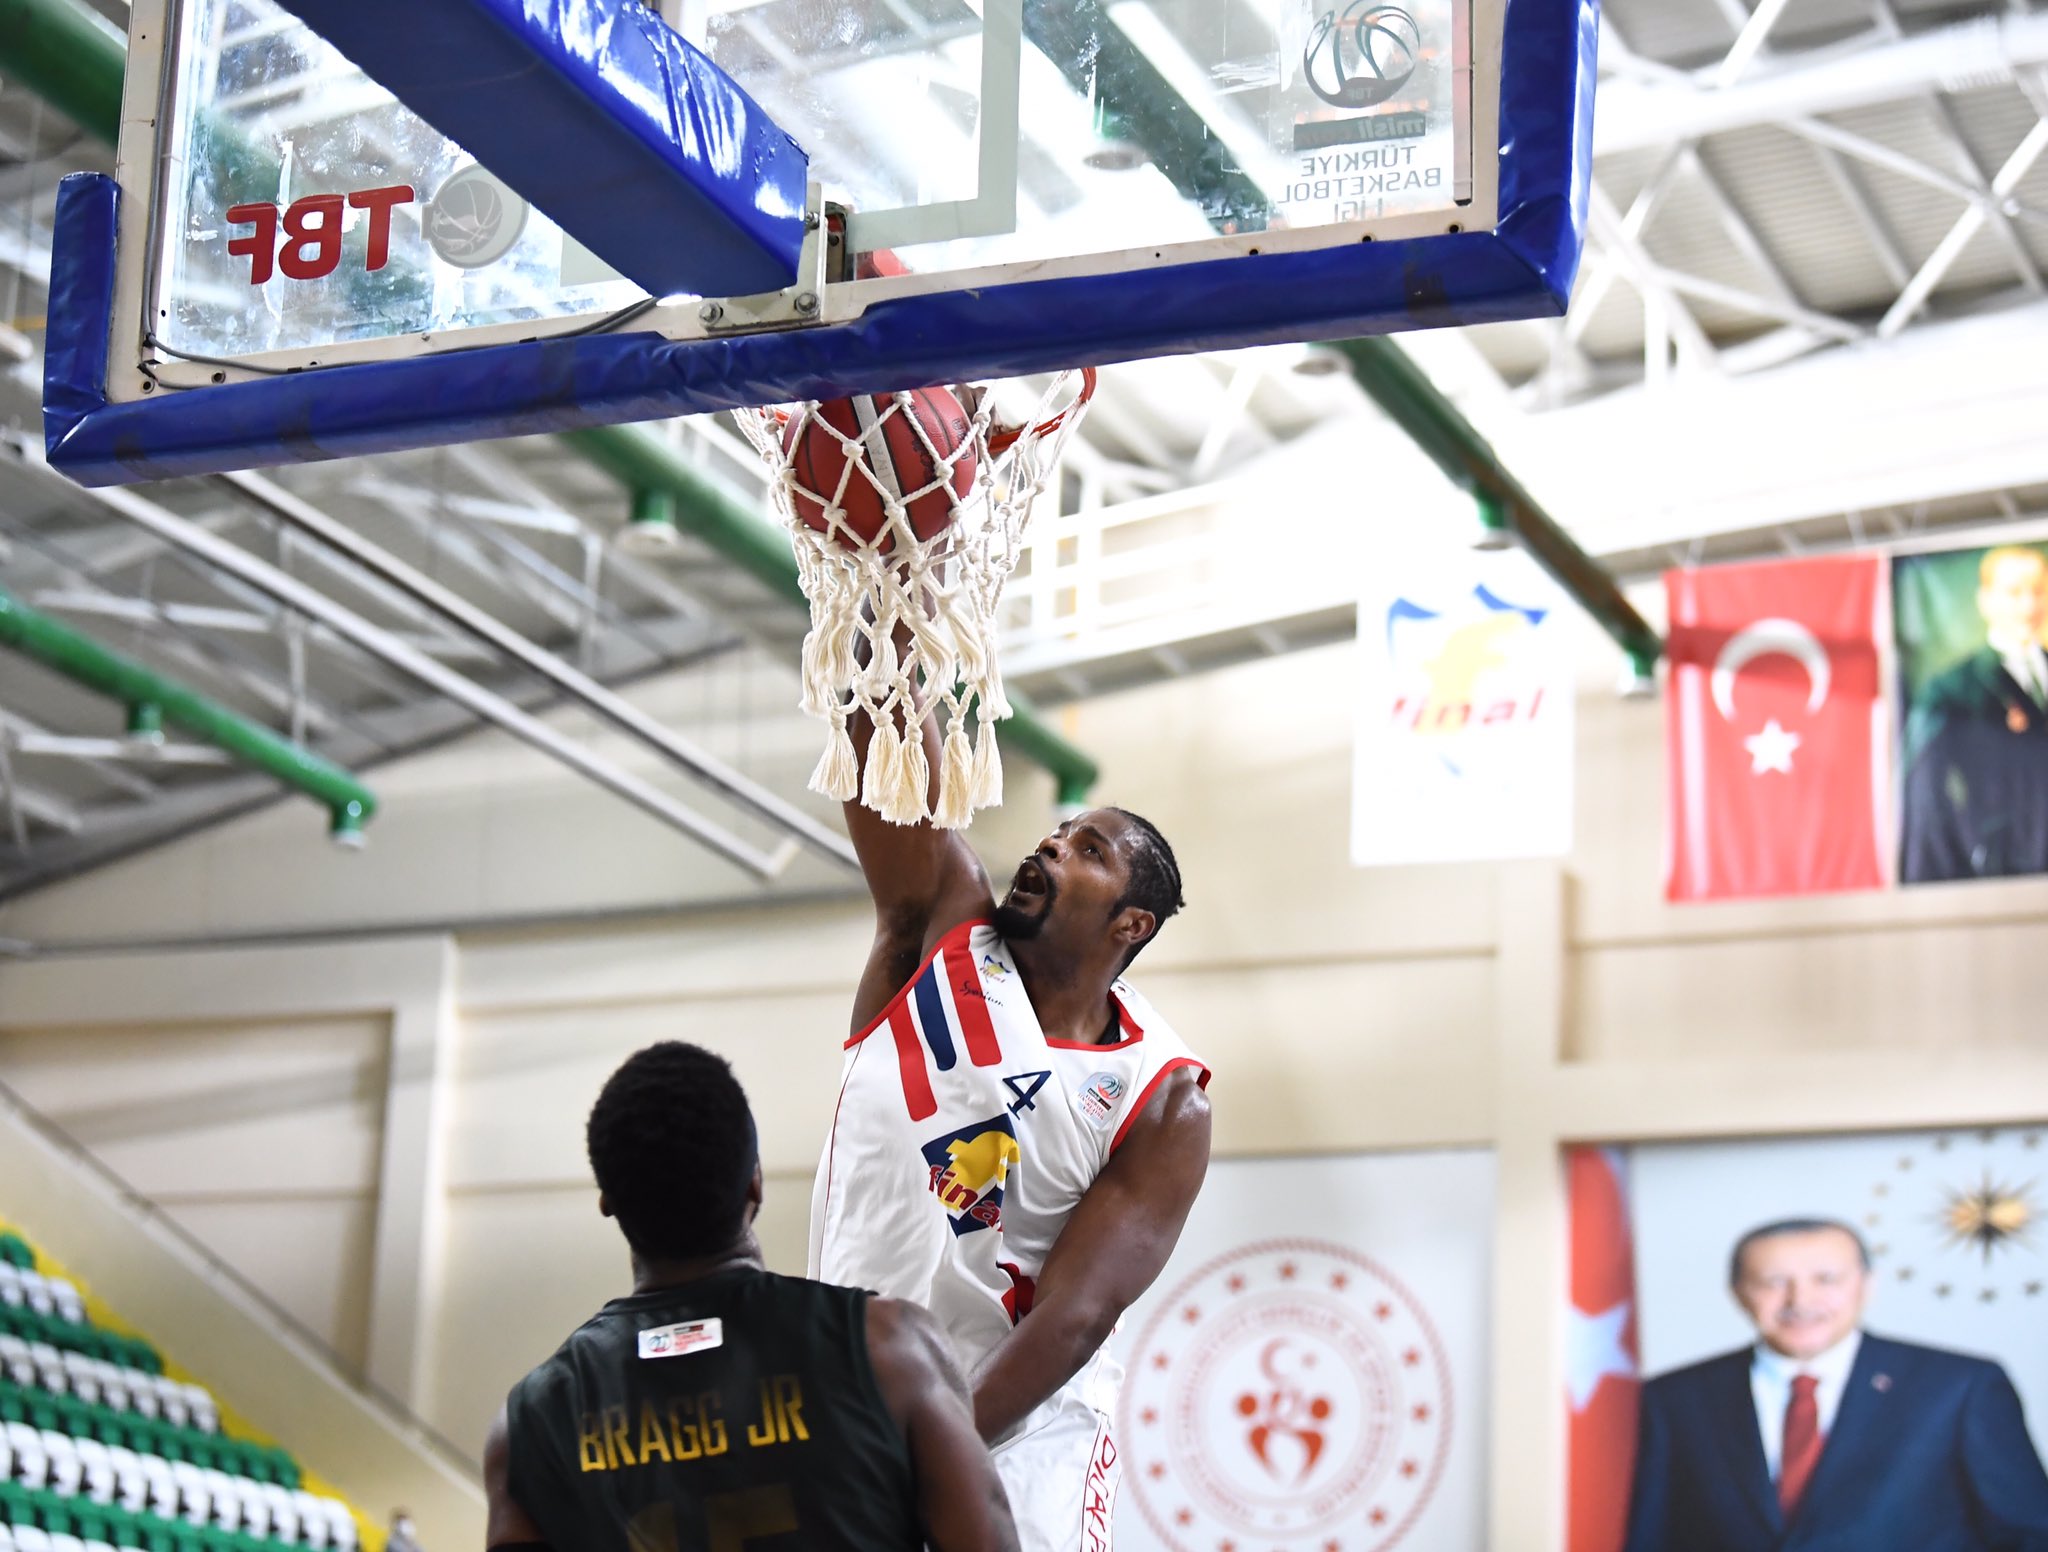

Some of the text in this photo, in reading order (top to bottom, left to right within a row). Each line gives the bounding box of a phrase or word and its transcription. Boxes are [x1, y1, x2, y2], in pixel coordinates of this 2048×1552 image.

[1002, 1070, 1052, 1121] 4
[927, 1163, 1004, 1232] fina
[578, 1374, 811, 1473] BRAGG JR
